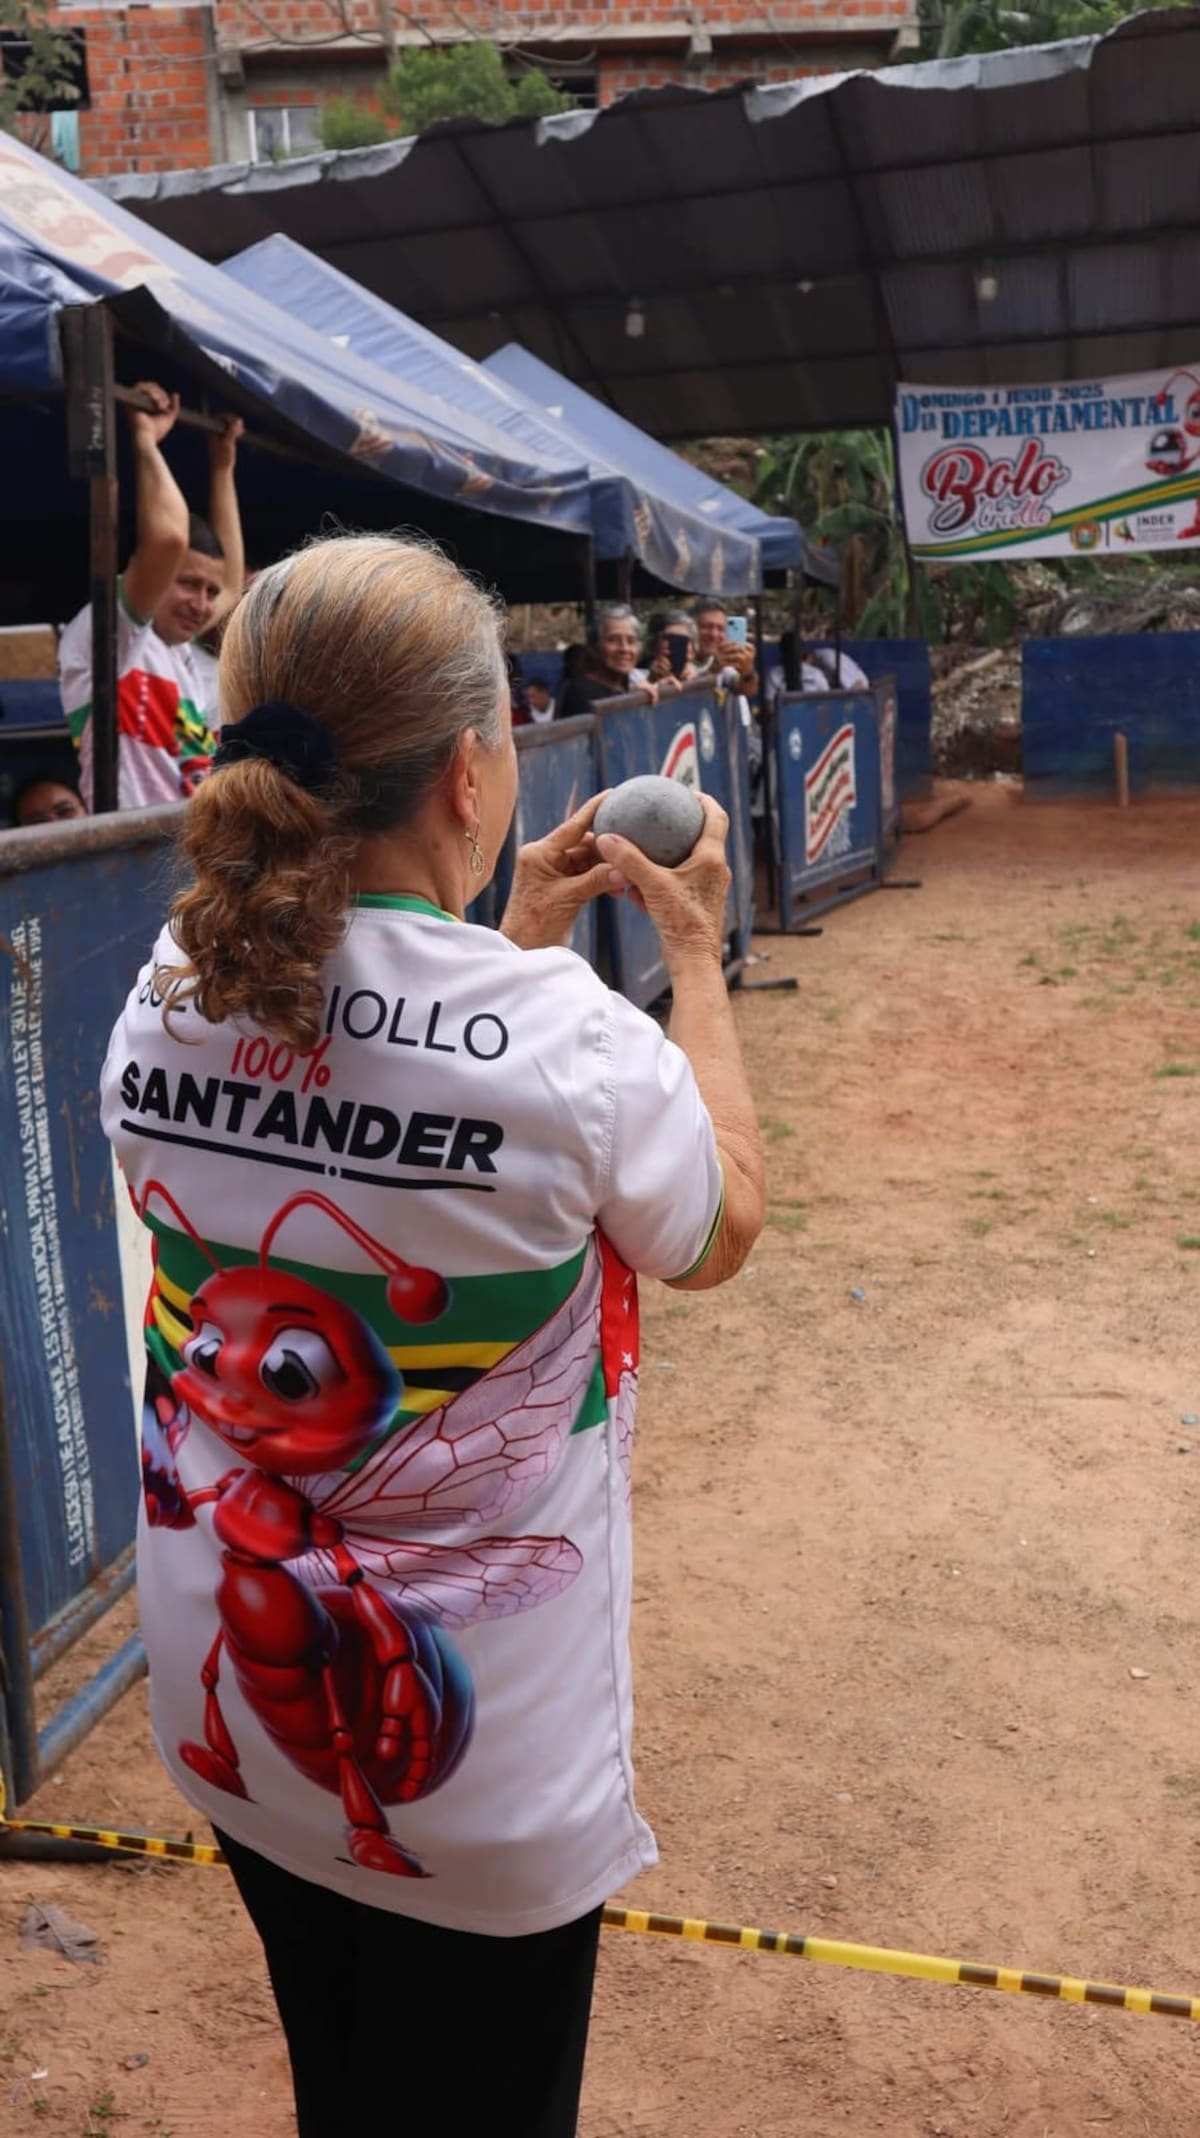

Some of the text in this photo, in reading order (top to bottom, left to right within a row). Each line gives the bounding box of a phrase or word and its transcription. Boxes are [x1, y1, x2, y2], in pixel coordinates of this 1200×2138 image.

[1058, 383, 1104, 401] 2025
[942, 394, 1179, 439] DEPARTAMENTAL
[924, 440, 1067, 533] Bolo
[1137, 513, 1175, 527] INDER
[29, 917, 41, 954] 1994
[11, 978, 28, 1008] DE
[326, 985, 509, 1061] IOLLO
[12, 1038, 30, 1074] LEY
[29, 1041, 45, 1084] EDAD
[231, 1035, 332, 1093] 100%
[16, 1075, 36, 1140] SALUD
[33, 1085, 47, 1104] DE
[120, 1060, 504, 1174] SANTANDER
[22, 1140, 38, 1168] LA
[35, 1107, 54, 1178] MENORES
[26, 1166, 43, 1218] PARA
[30, 1217, 59, 1334] PERJUDICIAL
[44, 1334, 62, 1358] ES
[60, 1442, 77, 1470] DE
[63, 1470, 85, 1540] EXCESO
[68, 1536, 86, 1566] EL
